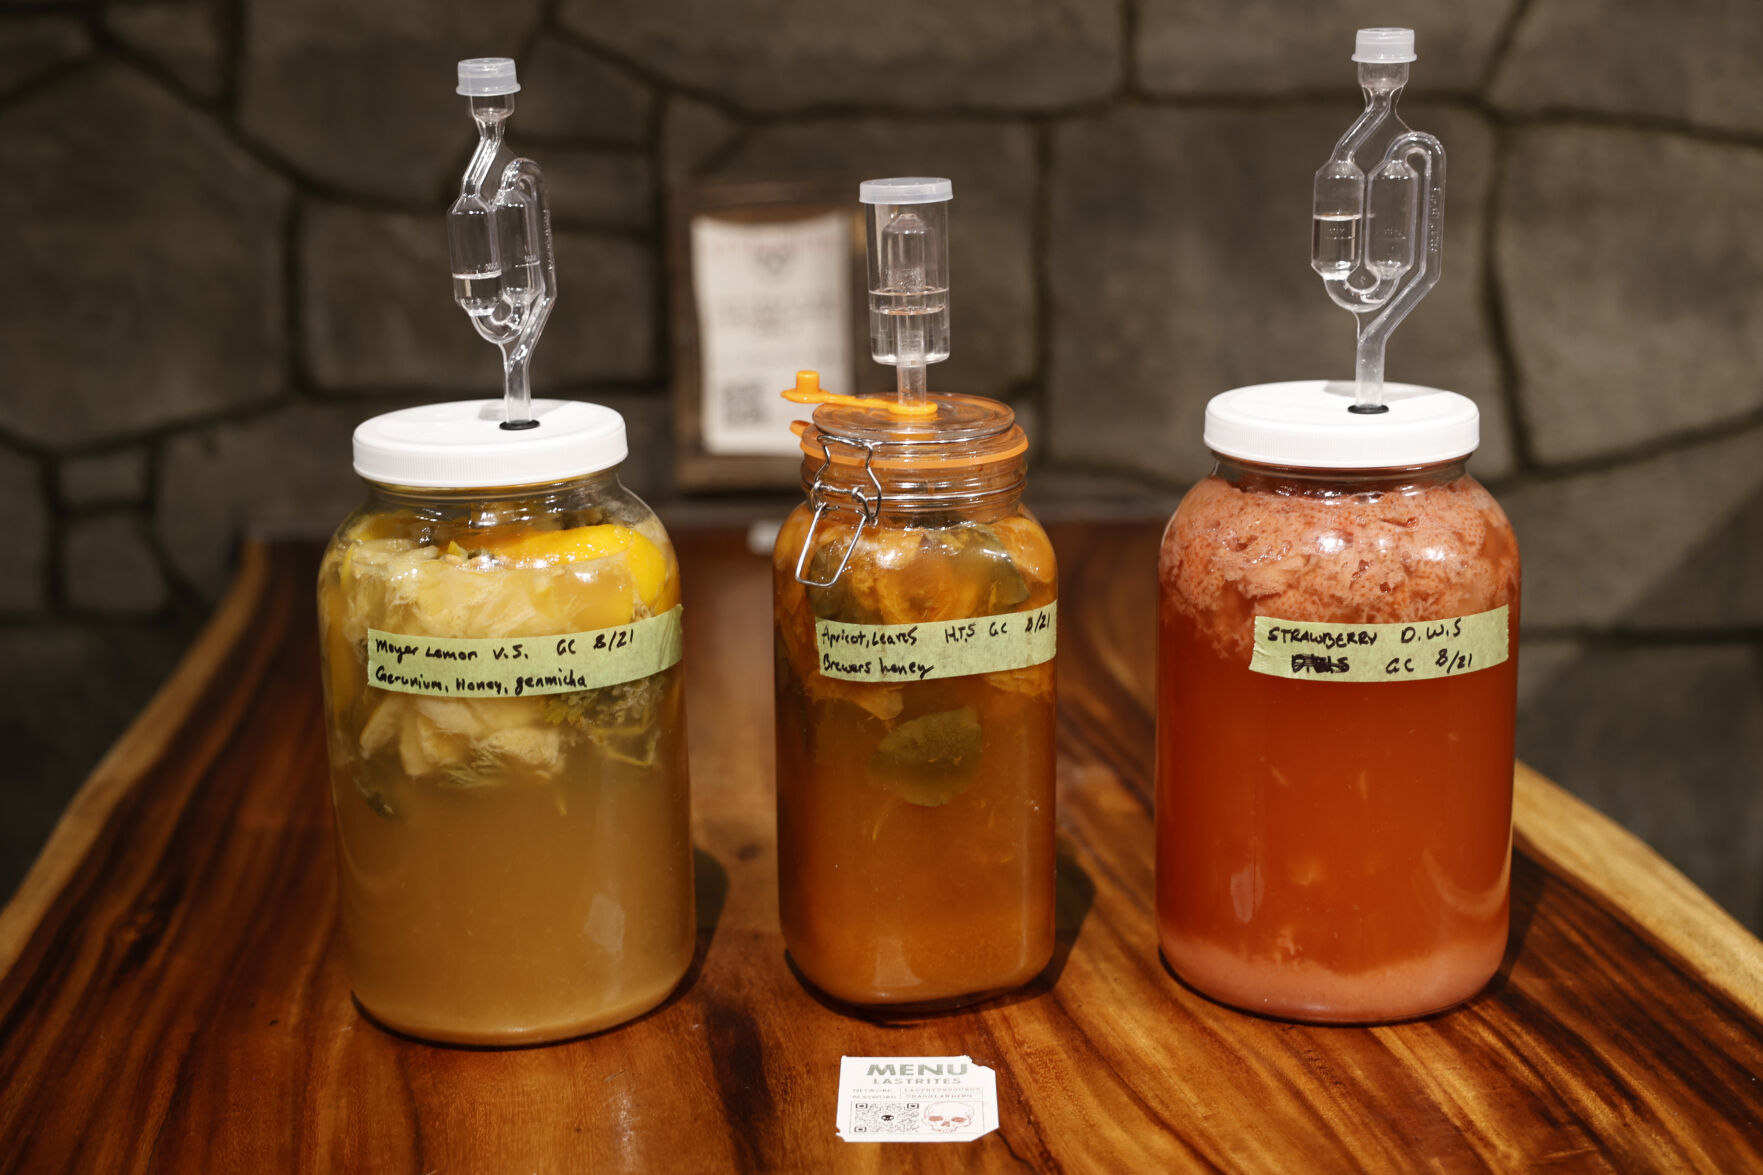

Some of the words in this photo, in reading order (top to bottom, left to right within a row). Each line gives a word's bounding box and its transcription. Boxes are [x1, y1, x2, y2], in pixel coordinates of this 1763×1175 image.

[593, 628, 634, 652] 8/21
[1267, 626, 1378, 650] STRAWBERRY
[1435, 648, 1472, 675] 8/21
[866, 1063, 968, 1076] MENU
